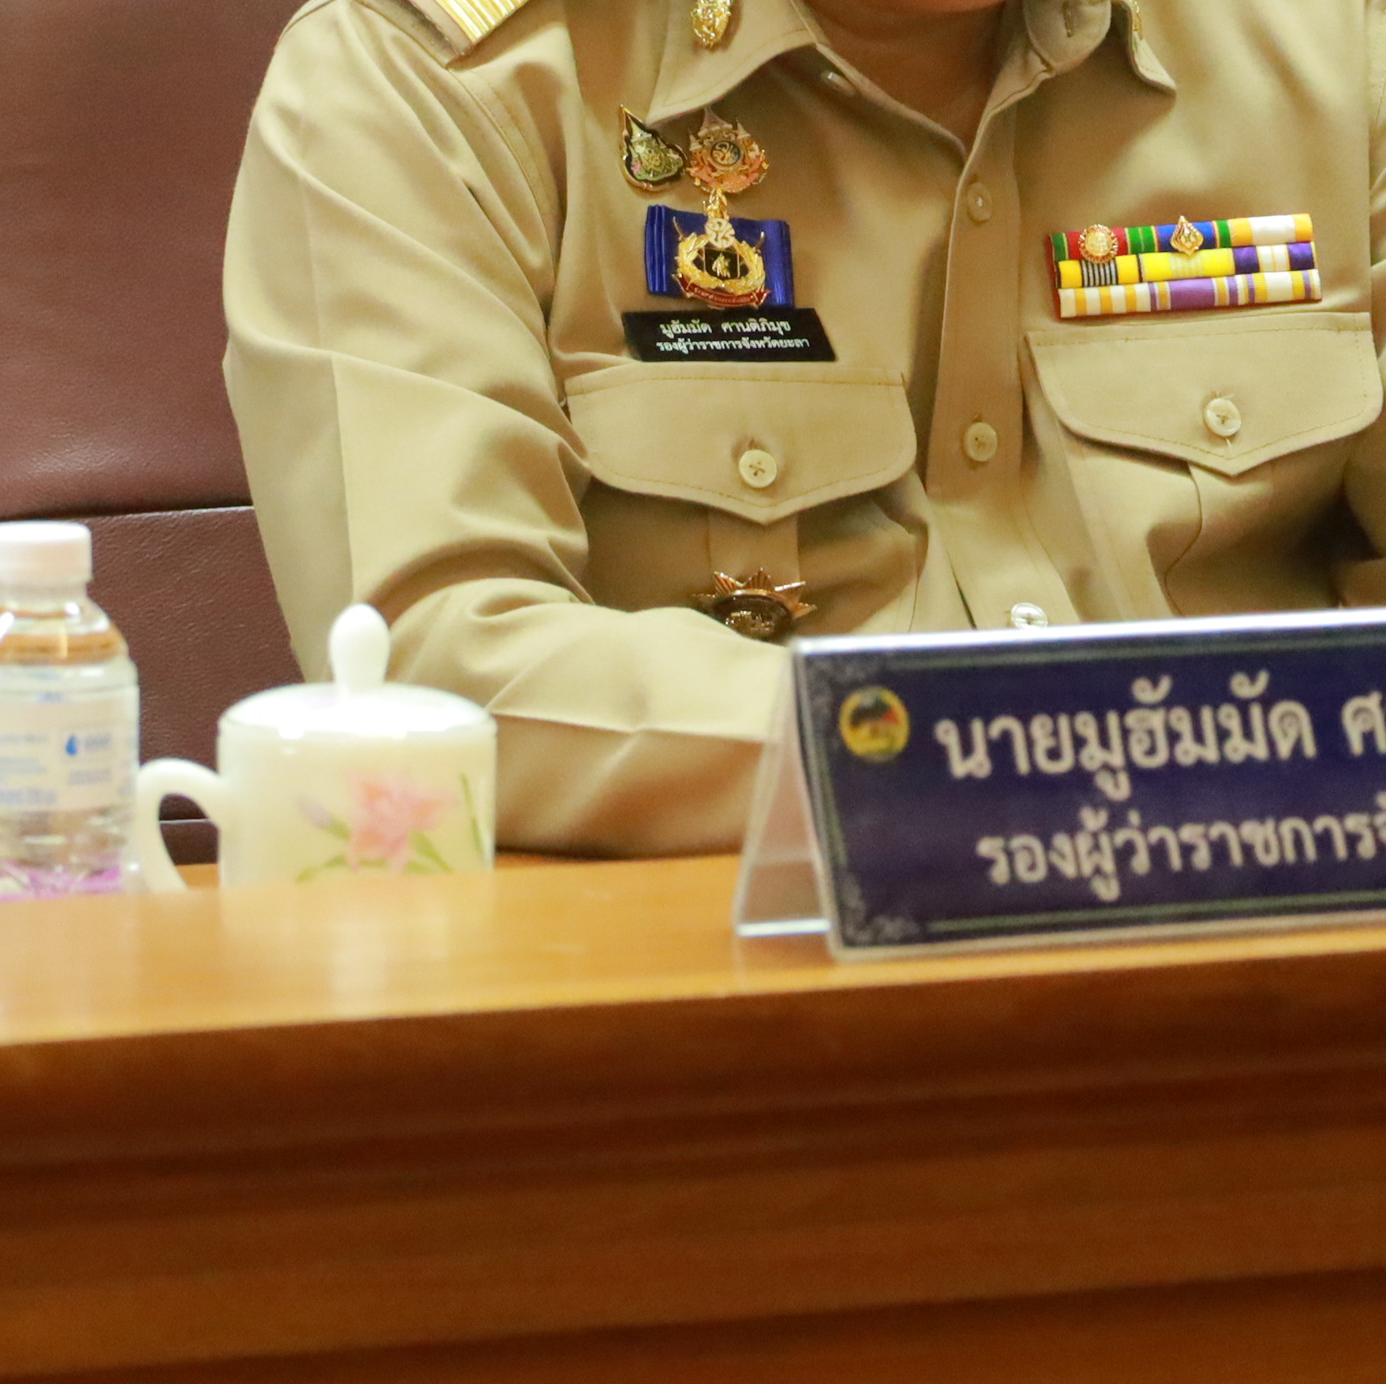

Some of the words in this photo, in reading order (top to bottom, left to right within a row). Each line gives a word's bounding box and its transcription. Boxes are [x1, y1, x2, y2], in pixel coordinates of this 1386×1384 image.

[655, 336, 810, 354] รองผู้ว่าราชการจังหวัดยะลา
[933, 670, 1317, 802] นายมูฮัมมัด
